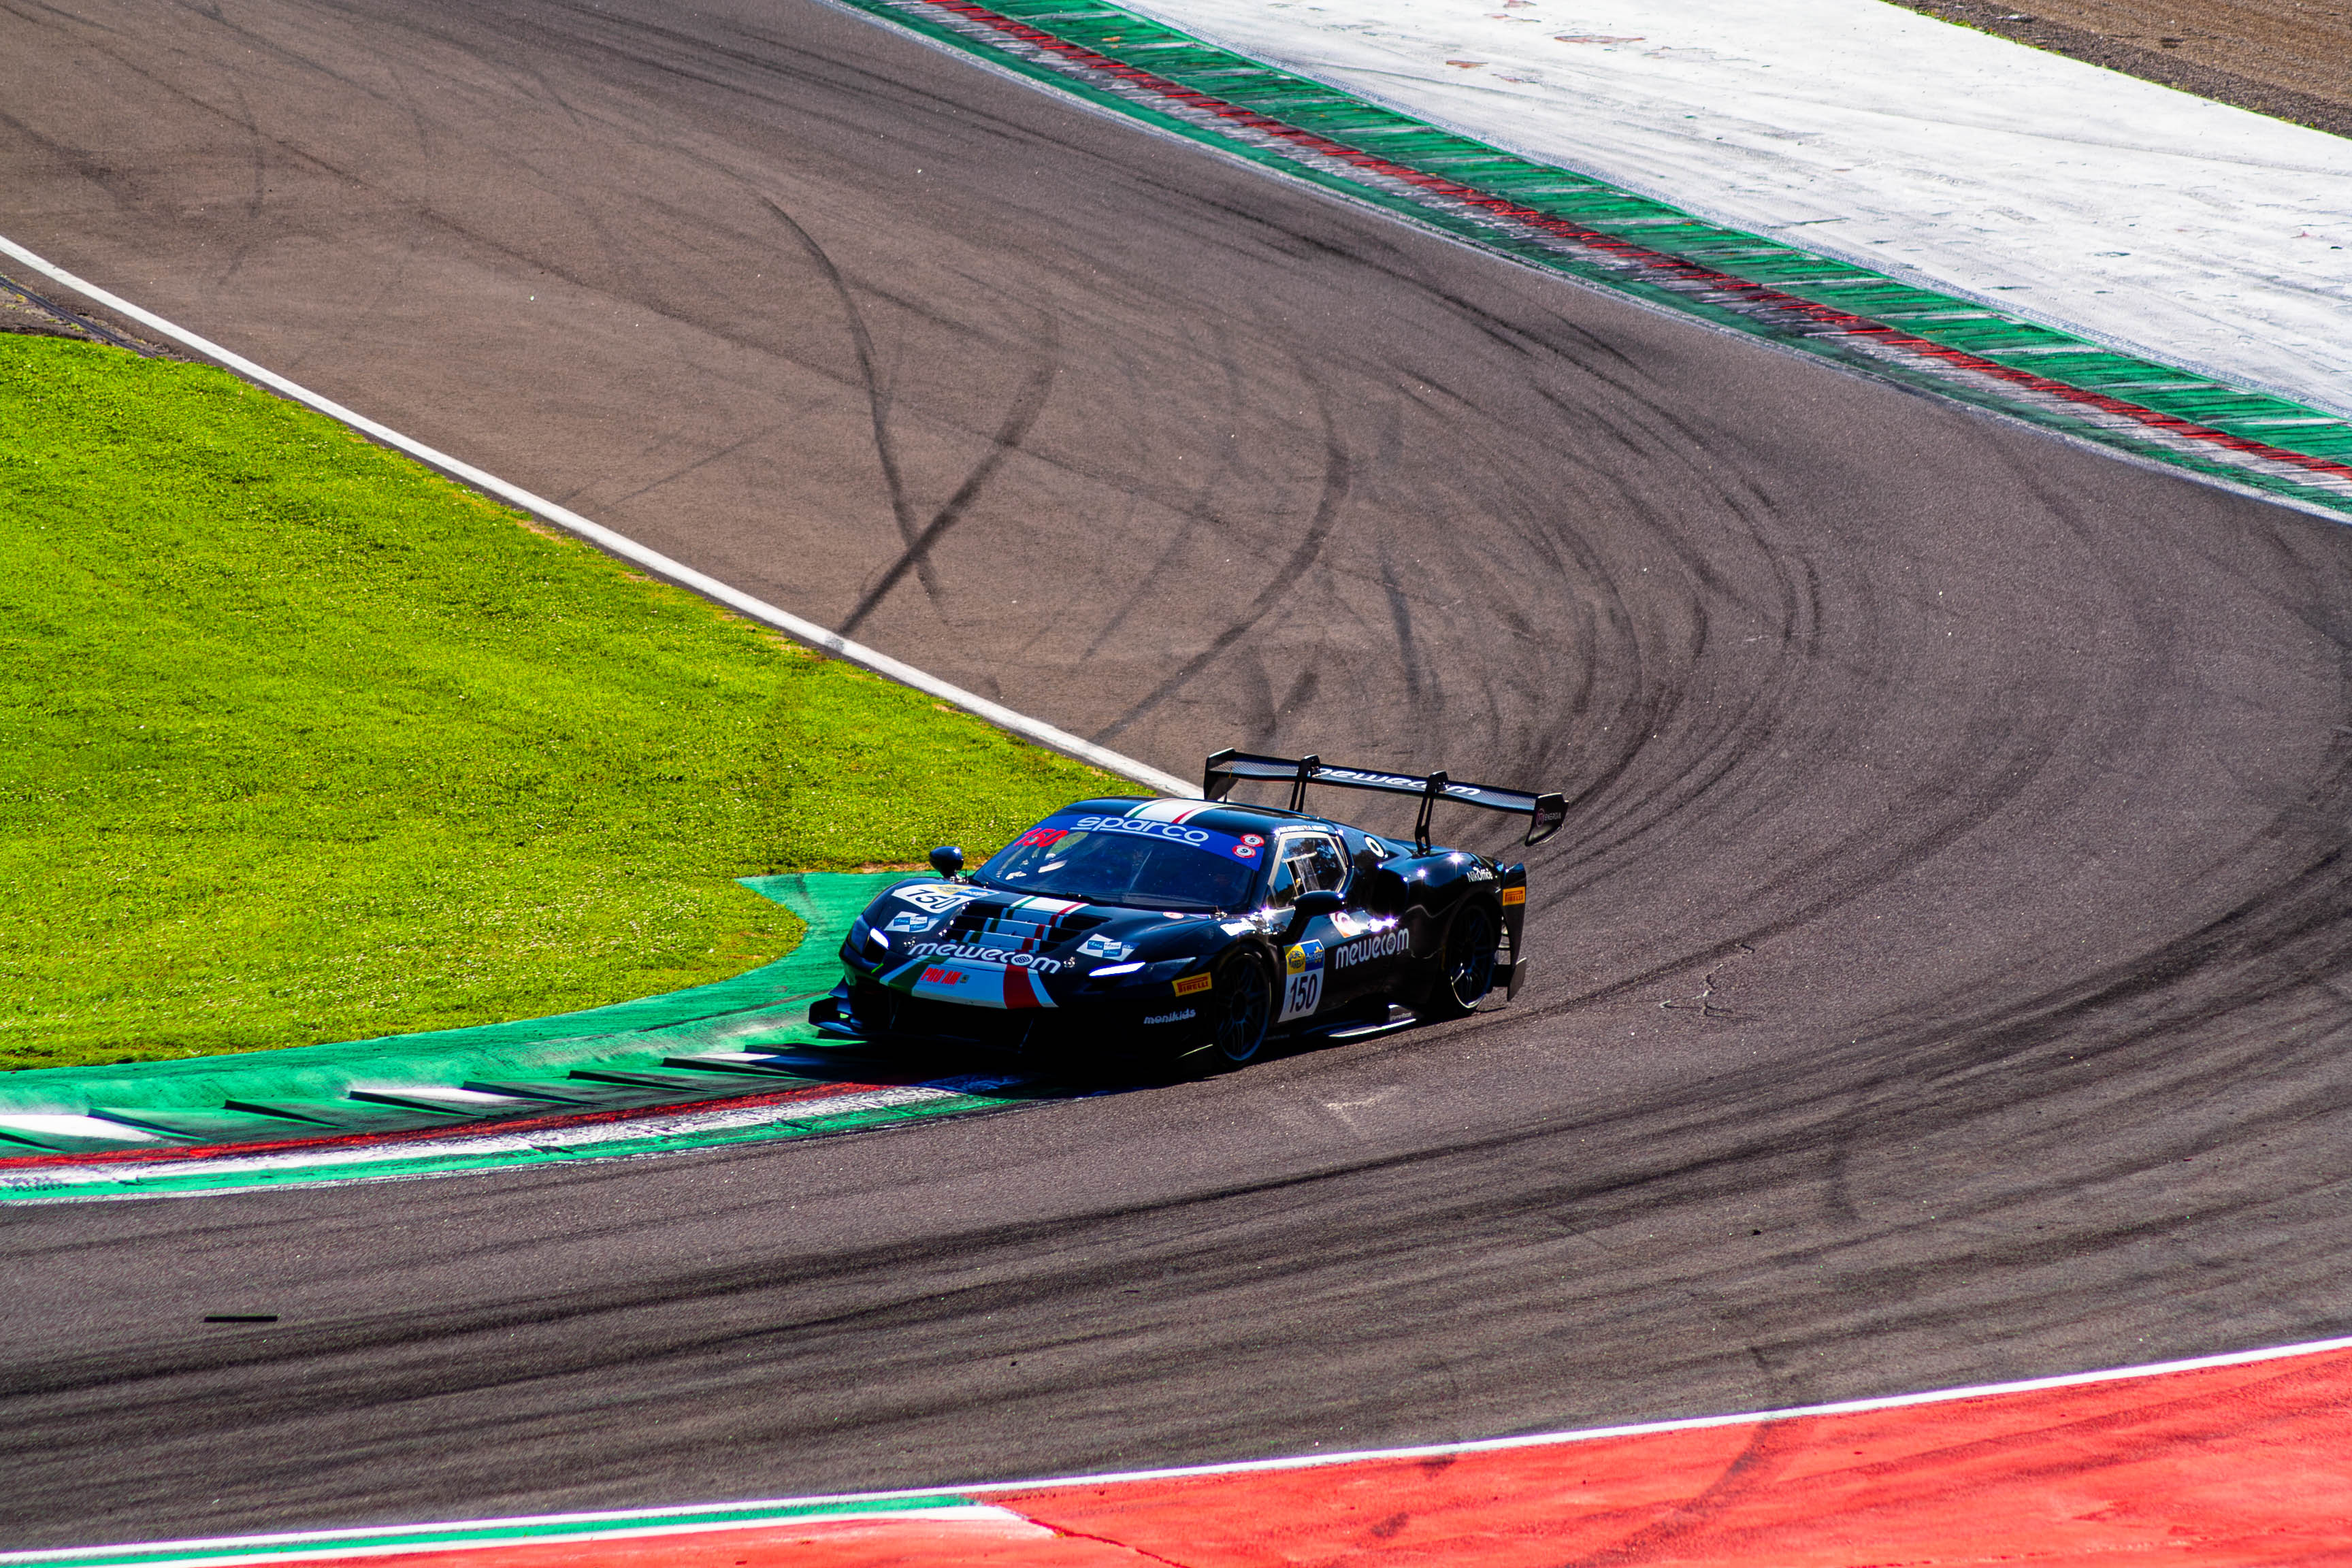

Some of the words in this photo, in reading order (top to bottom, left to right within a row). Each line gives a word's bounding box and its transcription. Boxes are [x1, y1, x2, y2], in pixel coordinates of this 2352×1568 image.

[1312, 767, 1480, 796] ewecm
[1014, 827, 1068, 847] 150
[1077, 816, 1209, 843] sparco
[906, 889, 961, 909] 150
[907, 943, 1061, 974] mewecom
[1336, 928, 1409, 969] mewecom
[920, 967, 945, 983] PRO
[941, 970, 962, 985] AM
[1177, 976, 1209, 994] PIRELLI
[1289, 974, 1318, 1013] 150
